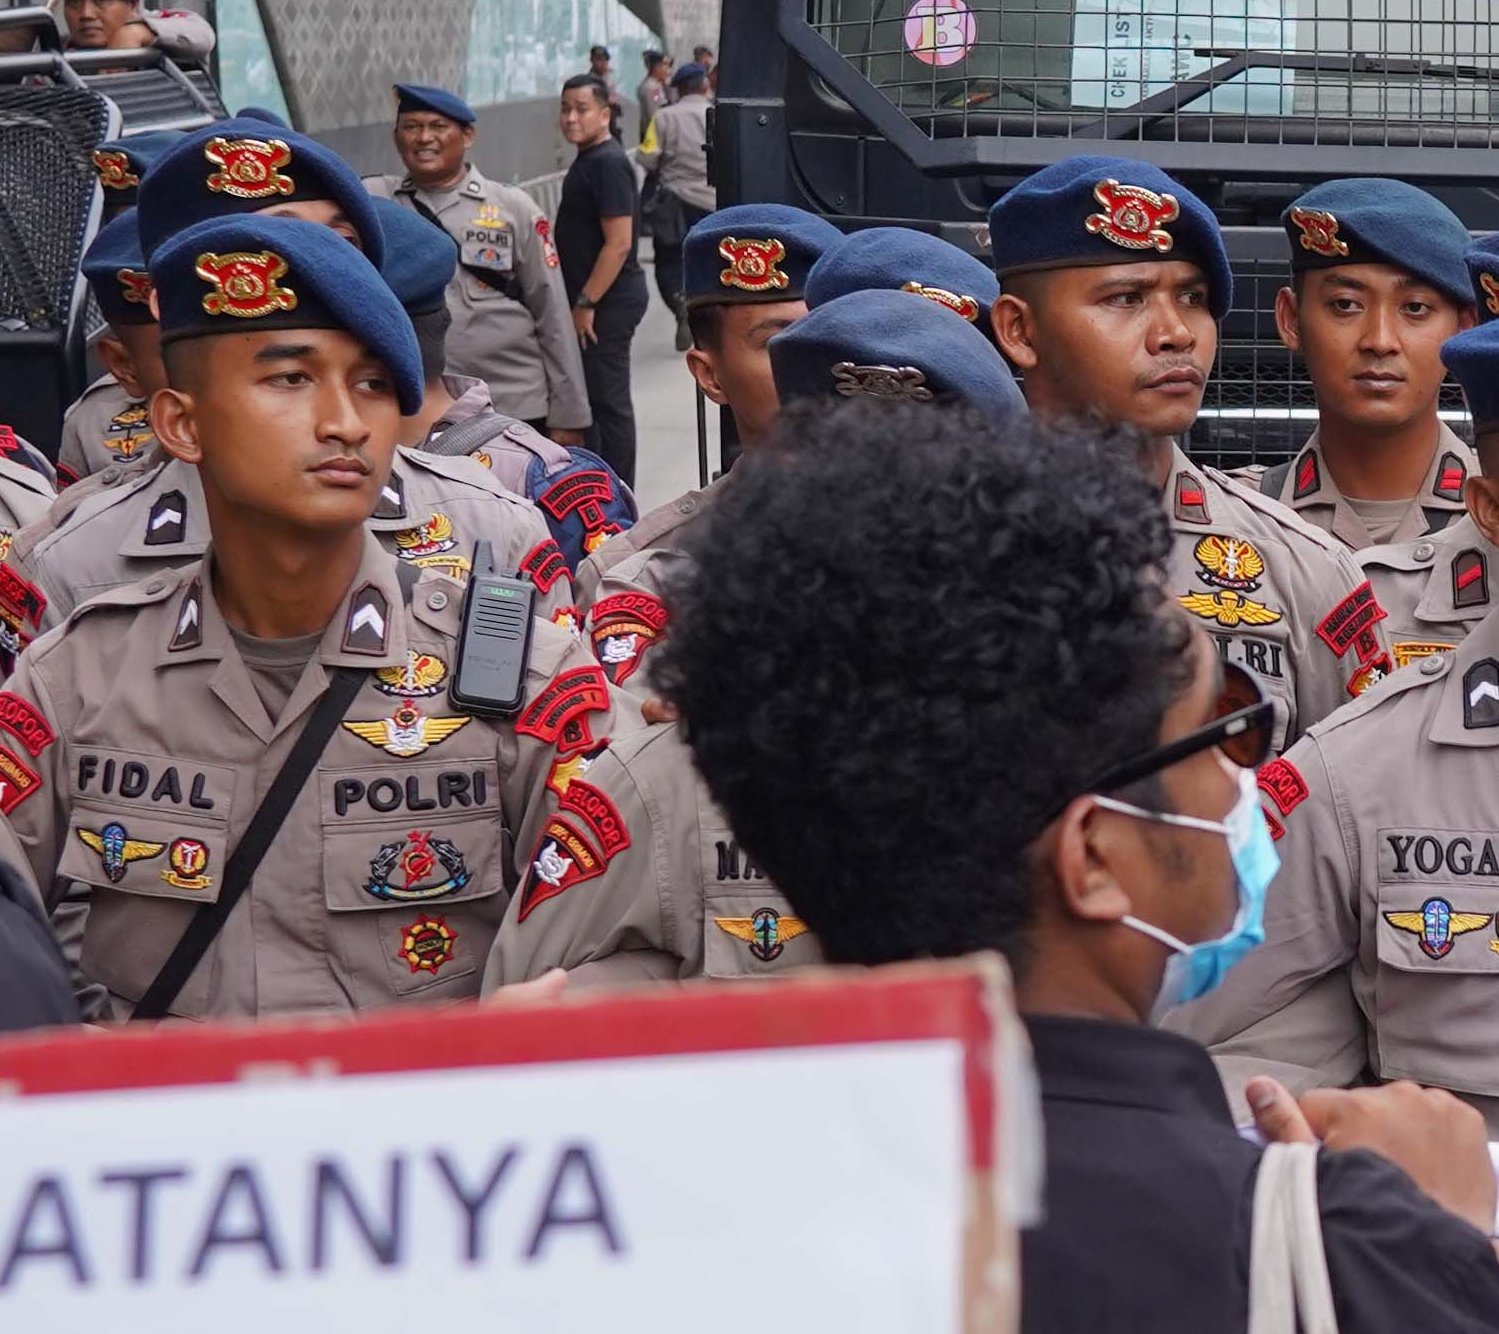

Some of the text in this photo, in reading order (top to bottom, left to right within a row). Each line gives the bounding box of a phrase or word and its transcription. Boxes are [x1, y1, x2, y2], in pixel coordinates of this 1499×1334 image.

[916, 6, 965, 54] B
[465, 230, 508, 248] POLRI
[77, 754, 215, 810] FIDAL
[334, 769, 487, 817] POLRI
